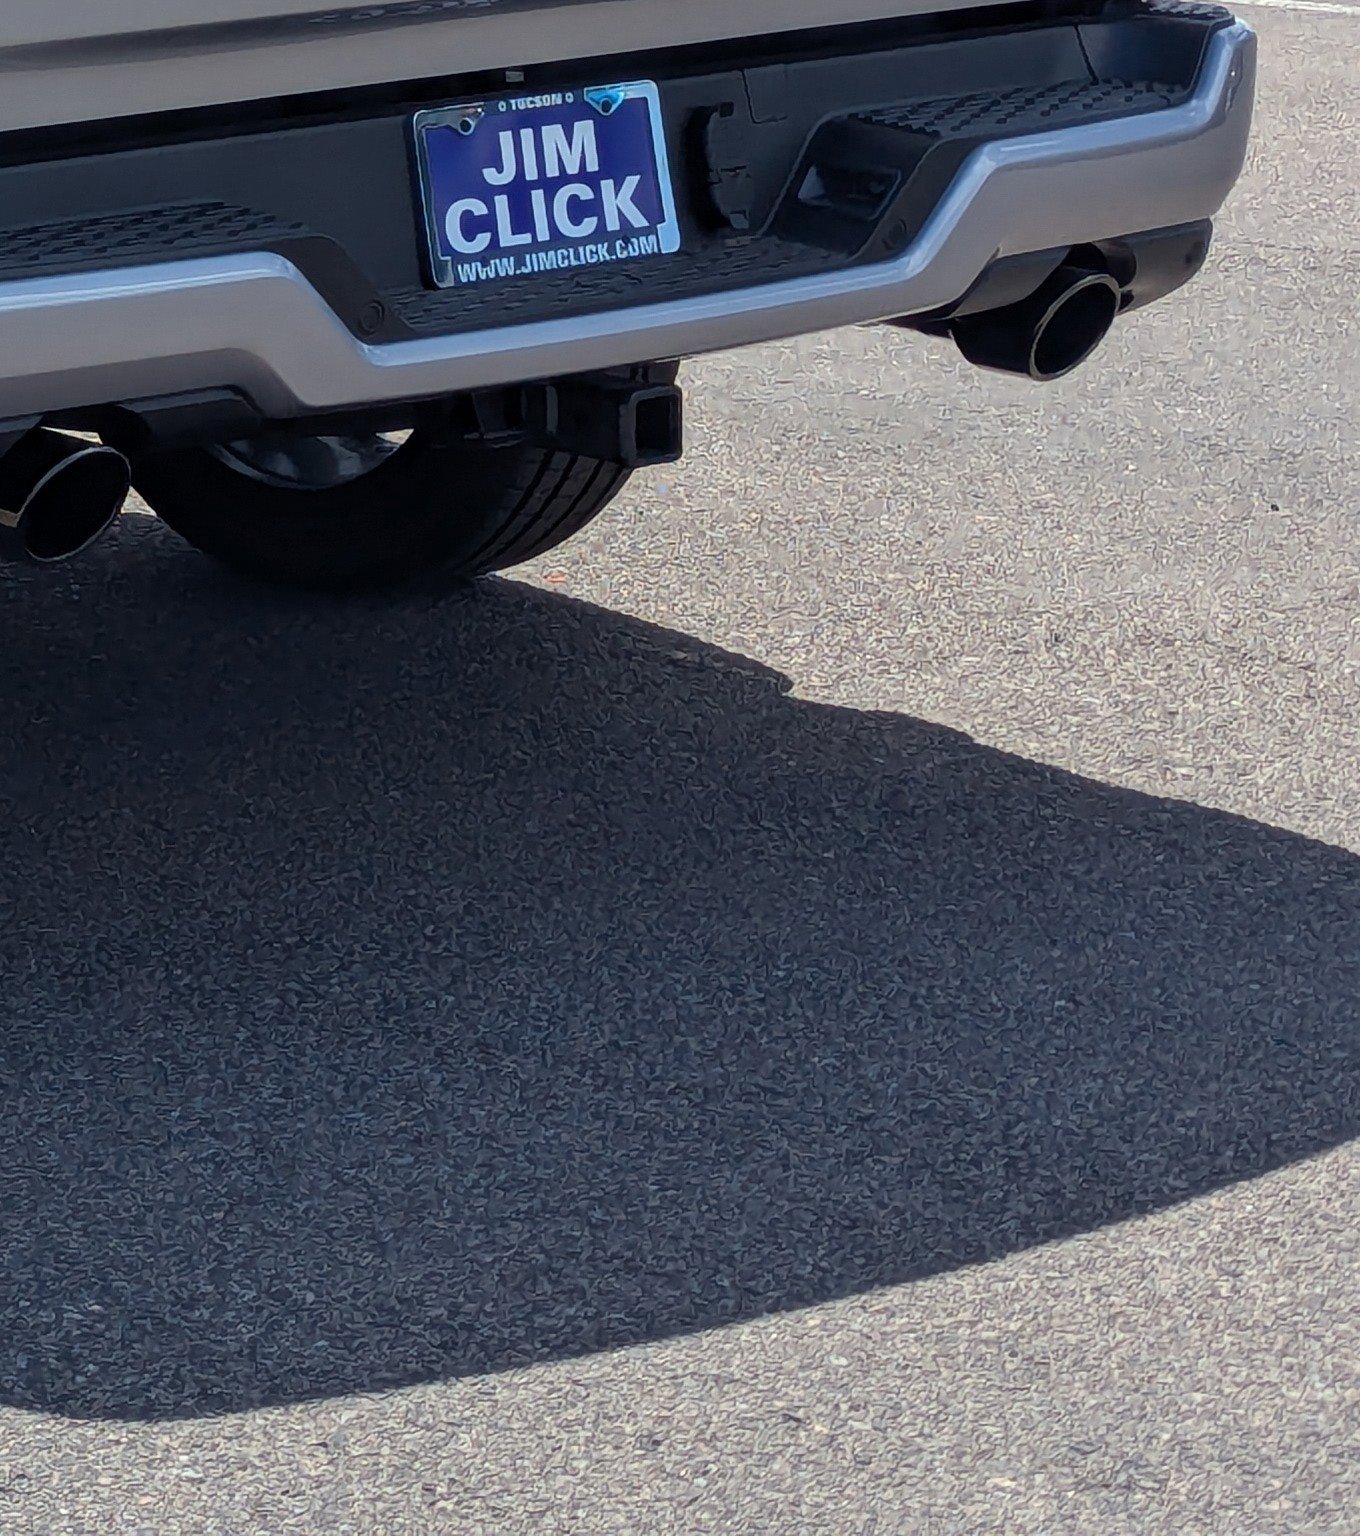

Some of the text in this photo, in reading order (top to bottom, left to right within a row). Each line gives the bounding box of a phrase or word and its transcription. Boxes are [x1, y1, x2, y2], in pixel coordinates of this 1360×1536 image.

[511, 92, 563, 112] TUCSON
[481, 119, 600, 186] JIM
[444, 174, 650, 255] CLICK
[456, 233, 660, 284] WWW.JIMCLICK.COM
